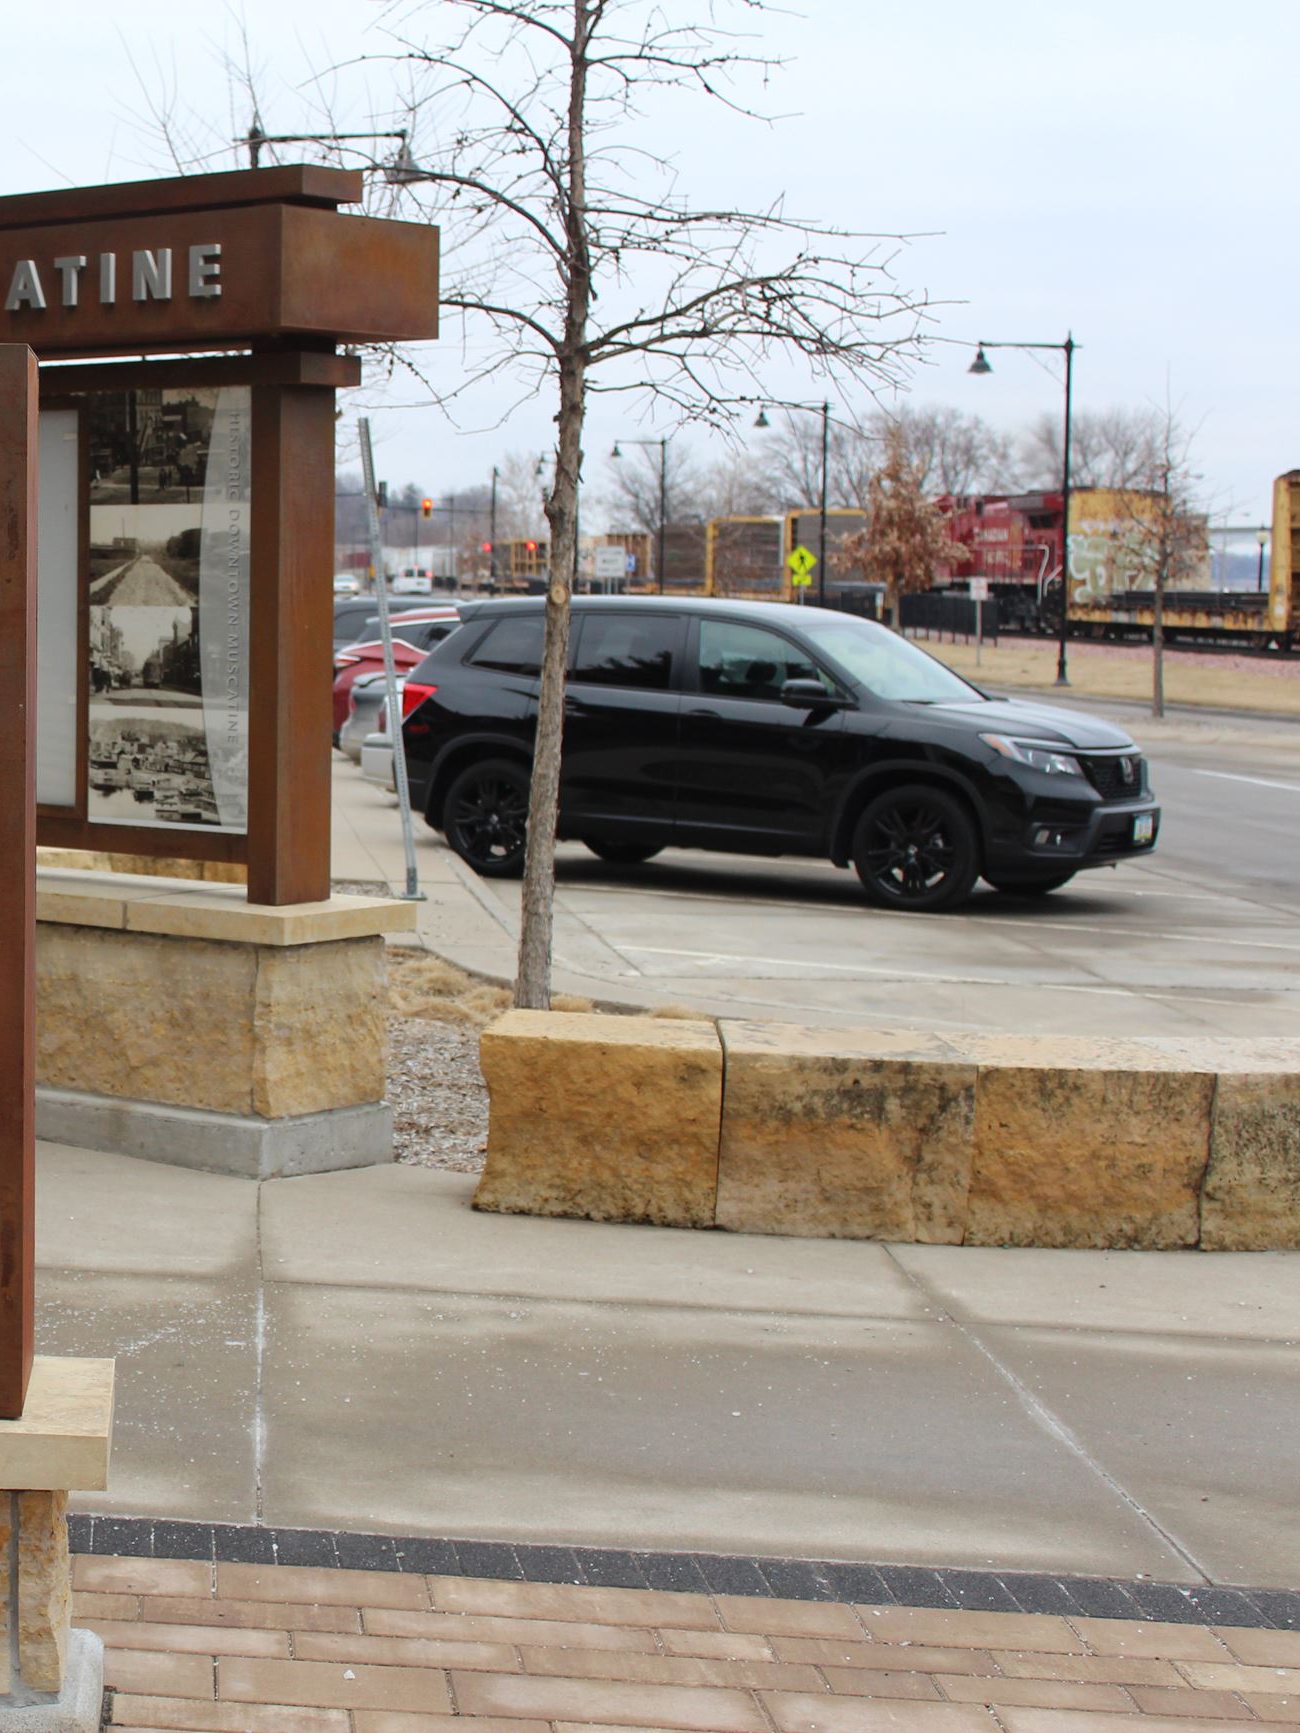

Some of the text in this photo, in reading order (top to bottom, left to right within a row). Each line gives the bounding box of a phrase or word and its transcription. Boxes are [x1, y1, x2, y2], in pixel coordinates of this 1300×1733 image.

[228, 413, 241, 743] HISTORIC DOWNTOWN MUSCATINE
